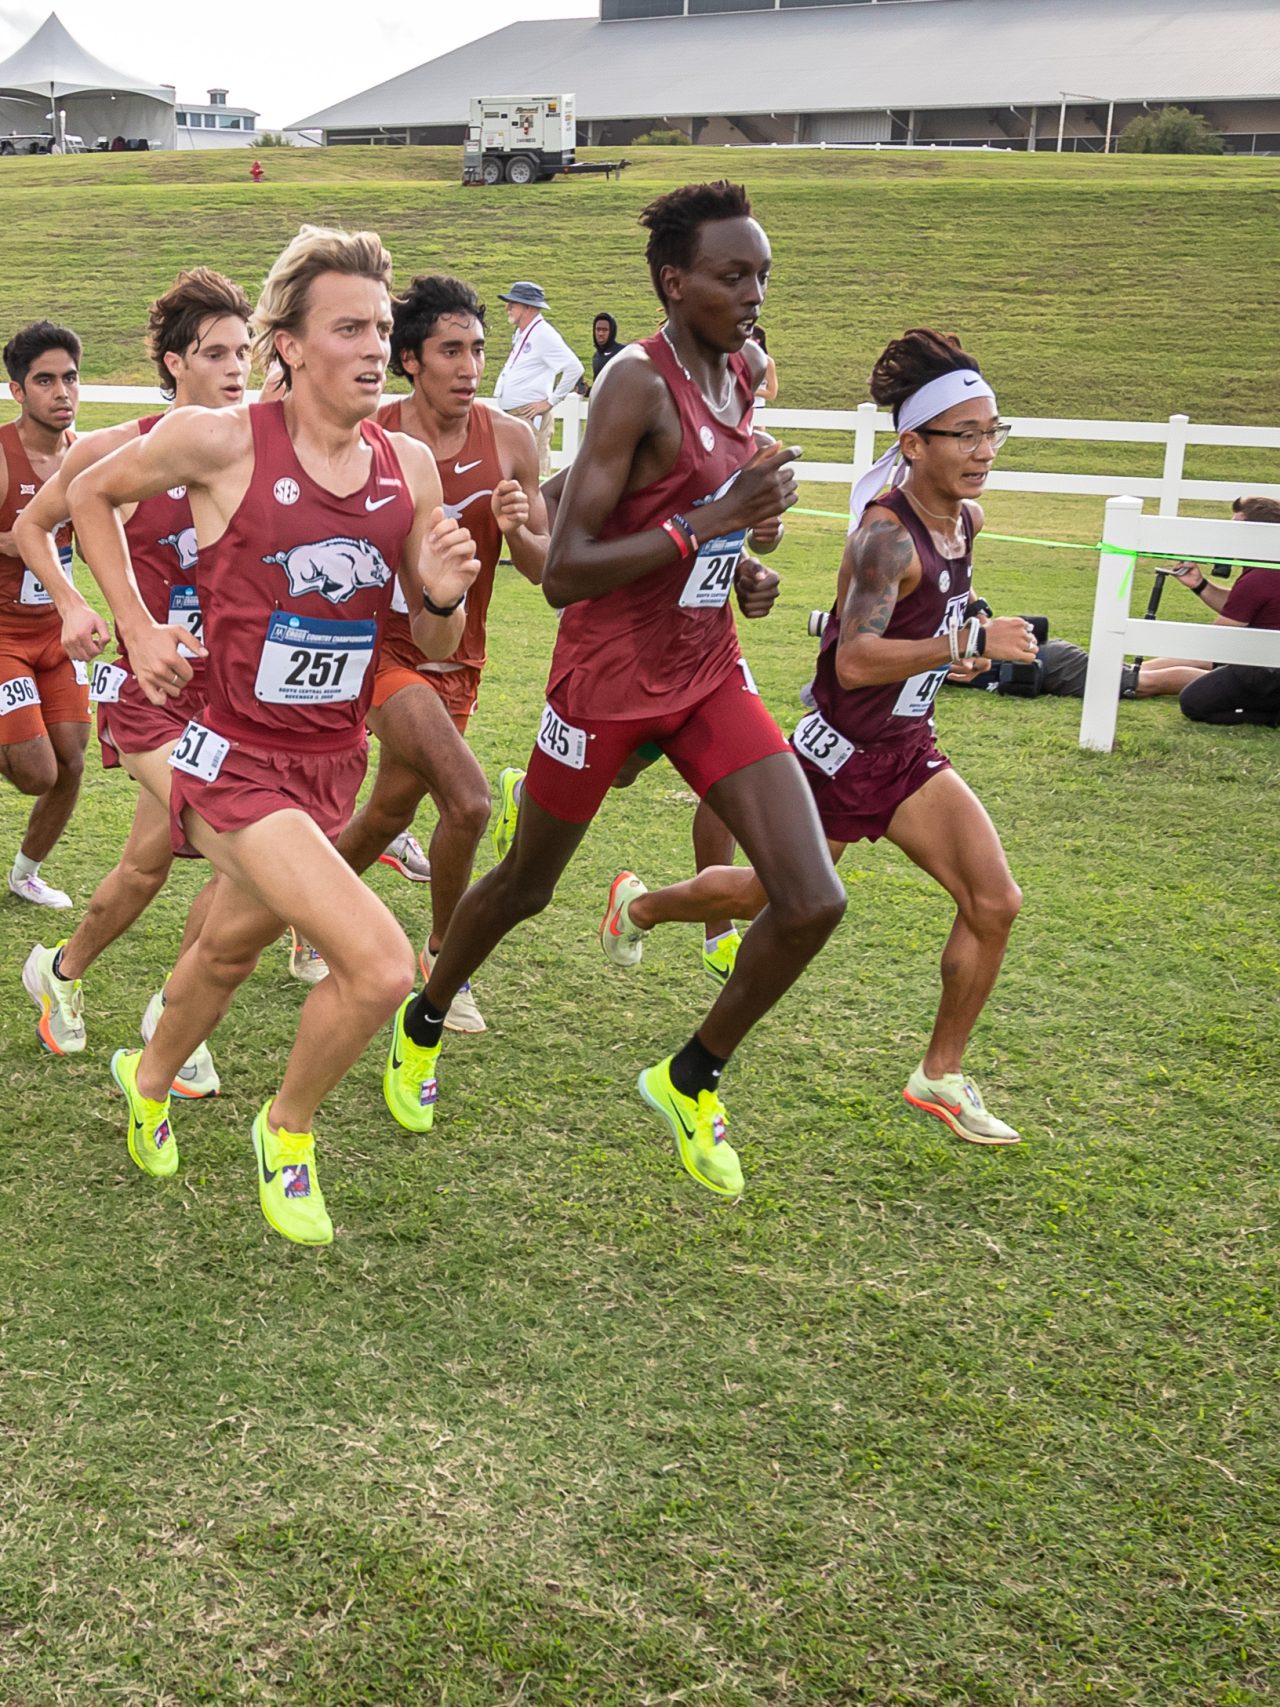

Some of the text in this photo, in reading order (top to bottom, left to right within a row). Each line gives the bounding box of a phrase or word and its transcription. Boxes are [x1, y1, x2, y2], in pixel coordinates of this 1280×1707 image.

[699, 556, 736, 591] 24
[306, 633, 333, 642] COUNTRY
[284, 650, 349, 687] 251
[2, 678, 34, 706] 396
[172, 724, 208, 768] 51
[540, 710, 570, 756] 245
[800, 716, 839, 759] 413
